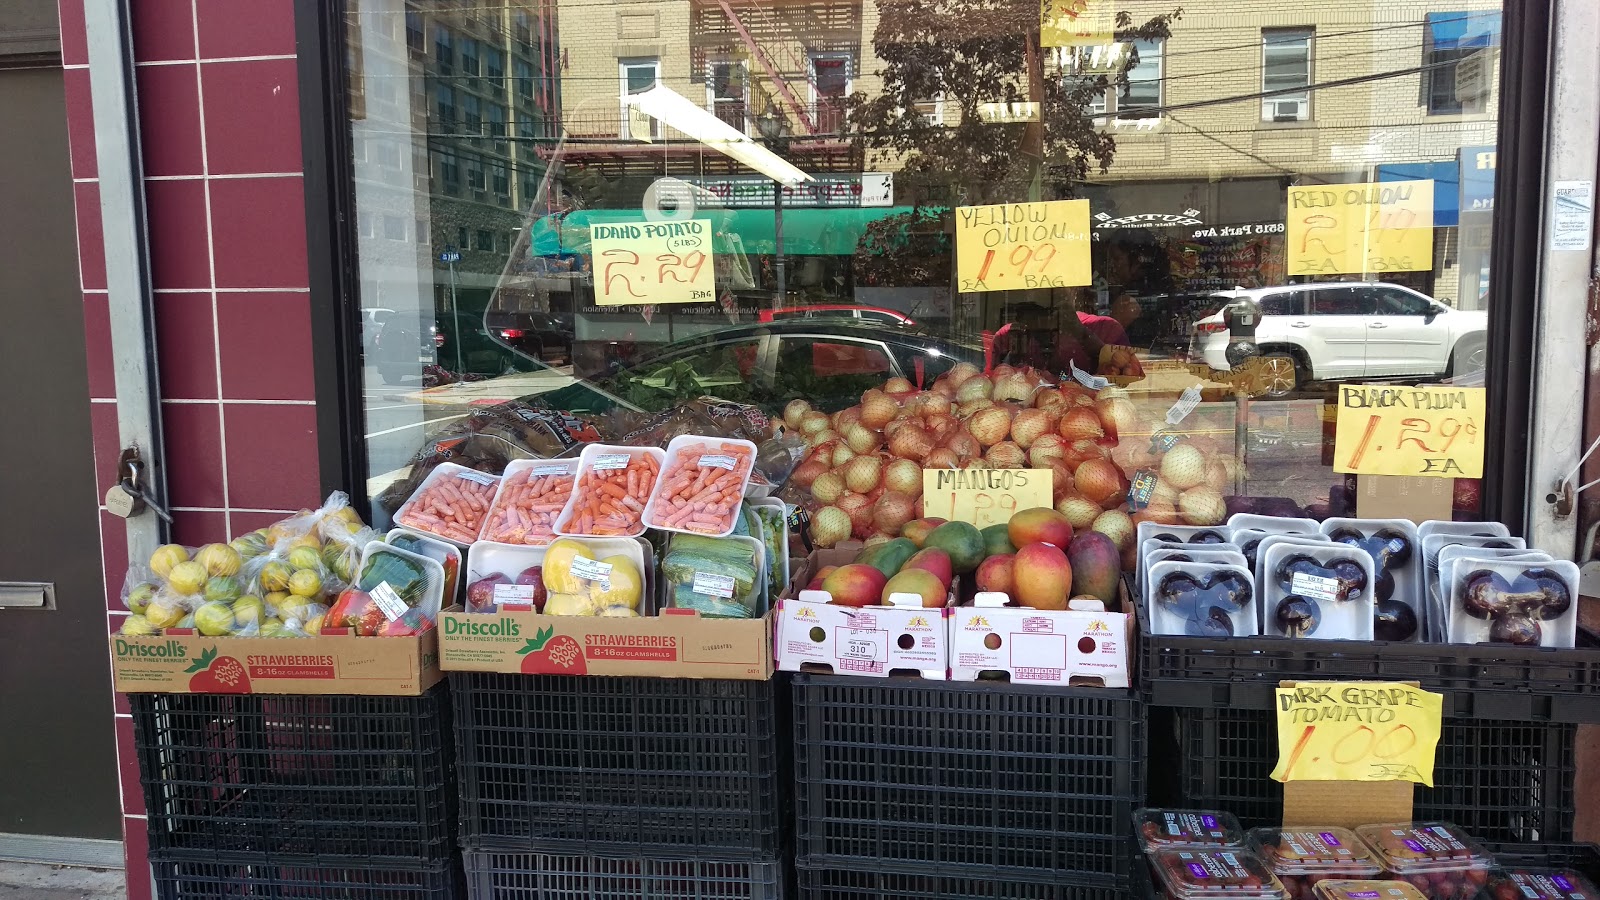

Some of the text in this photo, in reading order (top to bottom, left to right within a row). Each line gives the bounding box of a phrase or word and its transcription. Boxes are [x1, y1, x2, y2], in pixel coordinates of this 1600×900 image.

[1290, 185, 1414, 208] RED ONION
[961, 204, 1047, 228] YELLOW
[594, 222, 702, 239] IDAHO POTATO
[984, 222, 1066, 247] ONION
[977, 243, 1056, 280] 1.99
[1296, 256, 1414, 272] EA BAG
[602, 249, 706, 297] 2.29
[962, 275, 1066, 291] EA BAG
[690, 290, 712, 300] BAG
[1342, 387, 1466, 410] BLACK PLUM
[1419, 458, 1464, 474] EA
[937, 470, 1029, 490] MANGOS
[445, 616, 520, 636] Driscoll's
[793, 616, 820, 624] MARATHON
[116, 639, 187, 657] Driscoll's
[585, 633, 676, 647] STRAWBERRIES
[850, 645, 866, 653] 310
[247, 655, 334, 666] STRAWBERRIES
[1279, 686, 1424, 711] DARK GRAPE
[1291, 705, 1396, 724] TOMATO
[1280, 724, 1416, 781] 1.00
[1368, 763, 1424, 781] EA
